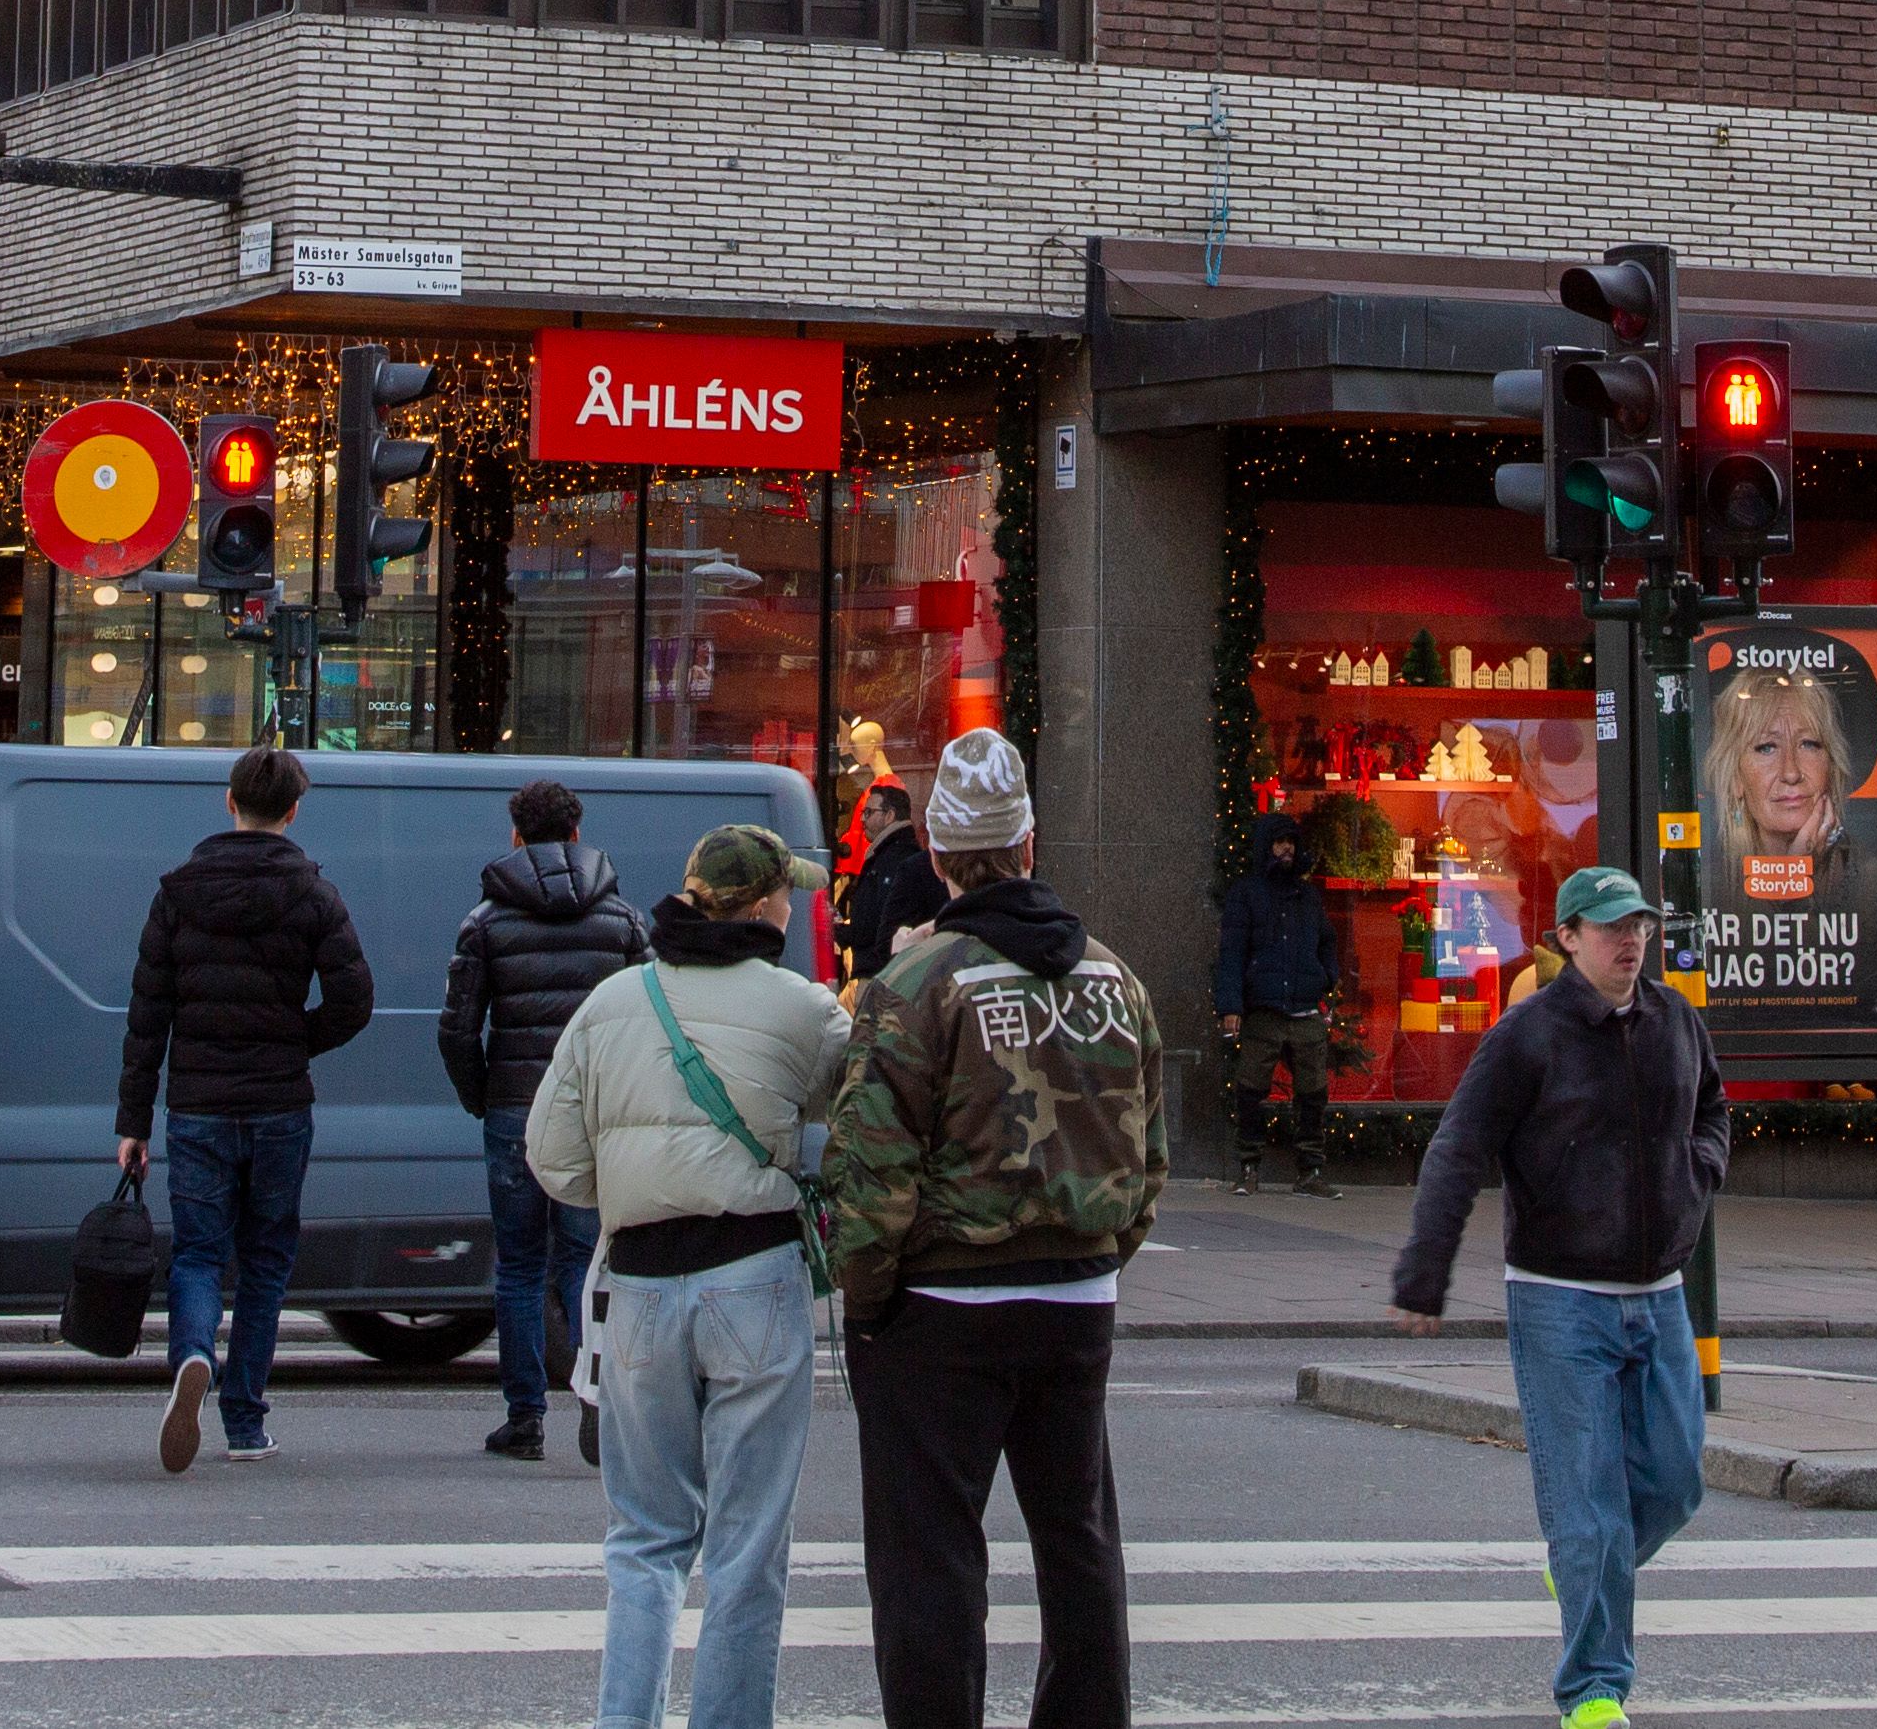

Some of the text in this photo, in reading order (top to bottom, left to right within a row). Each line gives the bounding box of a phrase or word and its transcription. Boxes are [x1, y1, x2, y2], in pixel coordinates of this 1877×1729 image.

[298, 245, 453, 267] Mäster Samuelsgatan
[298, 271, 345, 287] 53-63
[432, 281, 458, 291] Gripen
[575, 365, 804, 434] ÅHLÉNS
[1757, 611, 1793, 620] JCDecaux
[1736, 644, 1835, 675] storytel
[1751, 859, 1806, 877] Bara på
[1750, 878, 1808, 894] Storytel
[1702, 908, 1858, 947] ÄR DET NU
[1706, 947, 1856, 988] JAG DÖR?
[1742, 997, 1759, 1006] SOM
[1761, 997, 1816, 1006] PROSTITUERAD
[971, 981, 1138, 1051] 南火災
